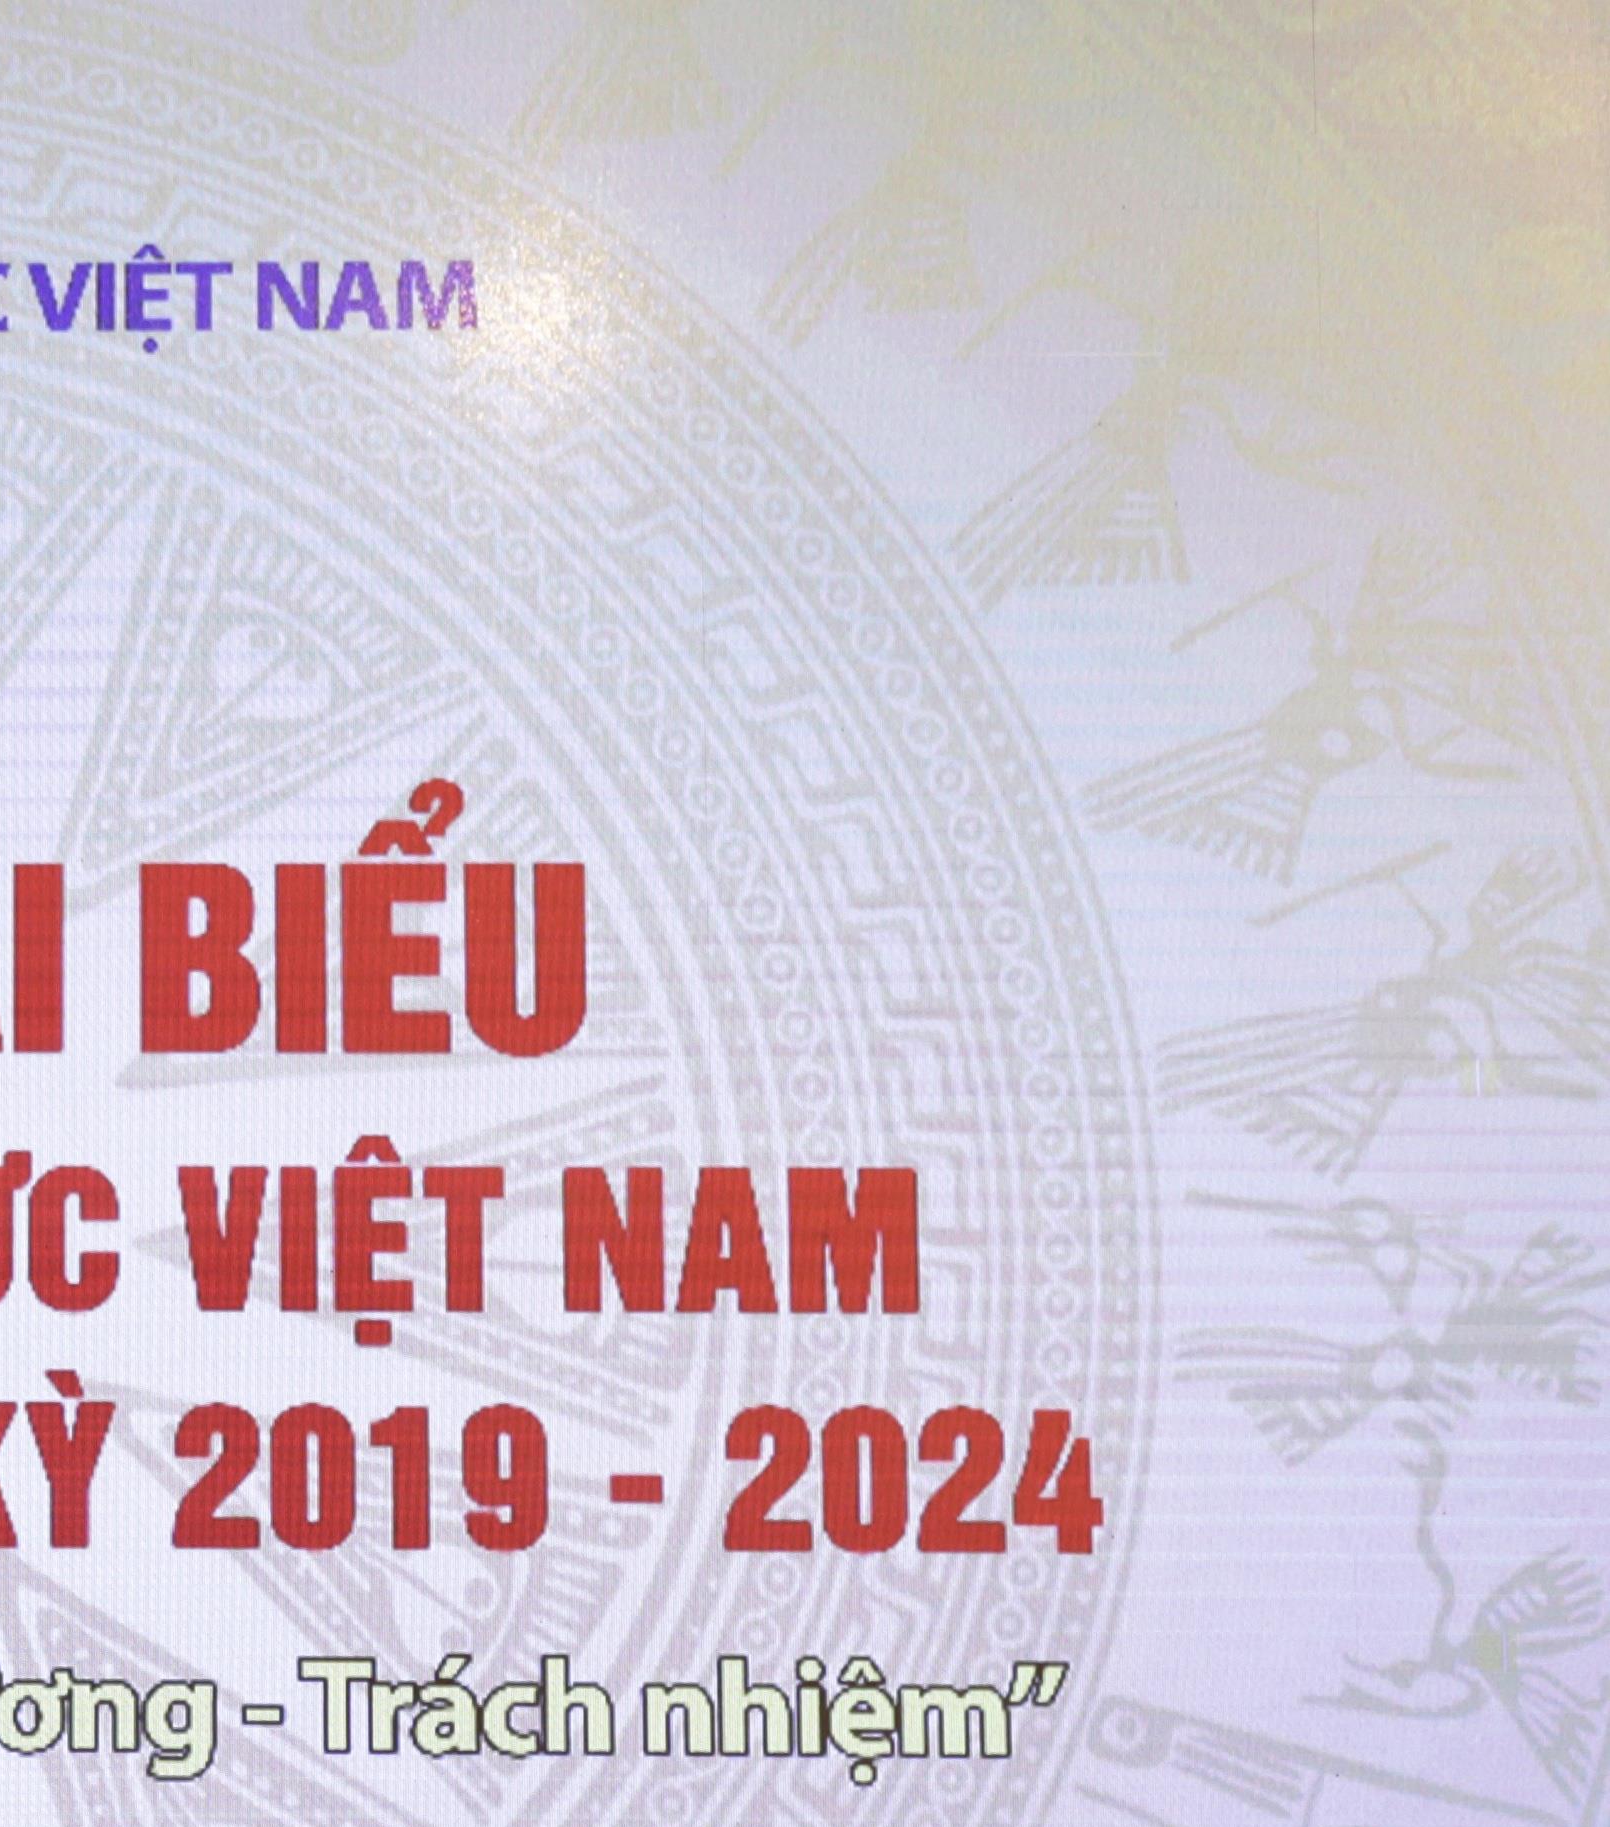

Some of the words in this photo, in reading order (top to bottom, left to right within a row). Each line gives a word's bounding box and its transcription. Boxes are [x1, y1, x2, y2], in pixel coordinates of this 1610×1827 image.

[27, 243, 234, 354] VIỆT
[257, 259, 478, 333] NAM
[140, 778, 587, 1058] BIỂU
[178, 1135, 505, 1346] VIỆT
[563, 1167, 919, 1314] NAM
[173, 1403, 548, 1552] 2019
[723, 1404, 1104, 1554] 2024
[296, 1653, 615, 1760] Trách
